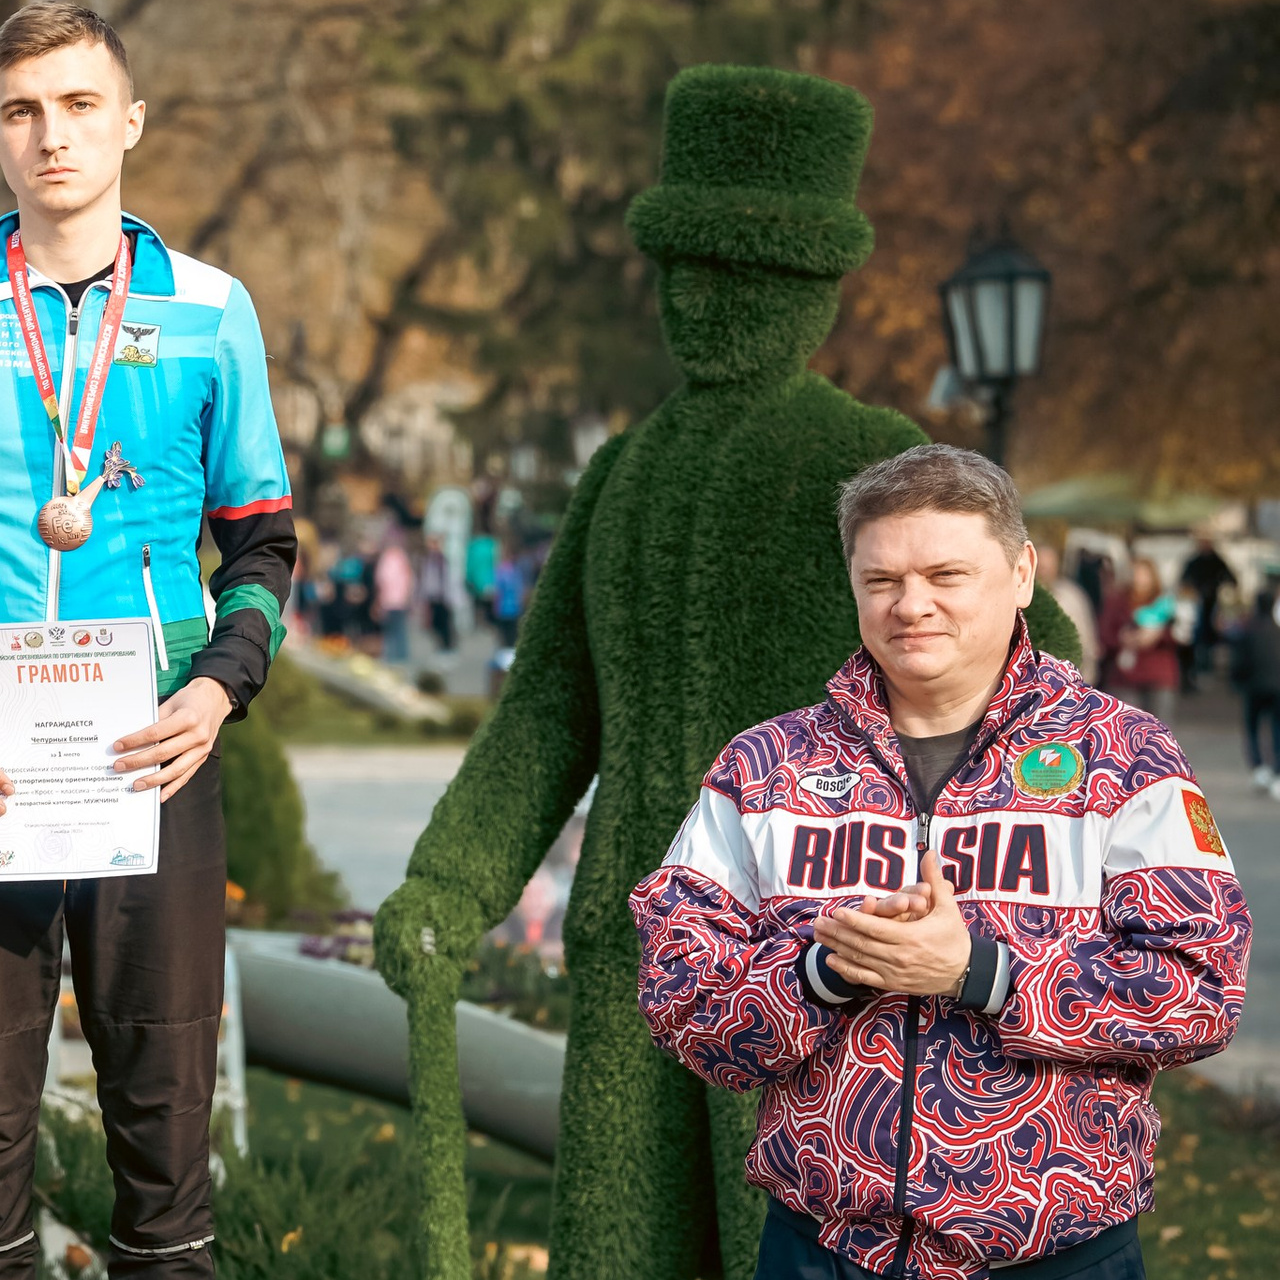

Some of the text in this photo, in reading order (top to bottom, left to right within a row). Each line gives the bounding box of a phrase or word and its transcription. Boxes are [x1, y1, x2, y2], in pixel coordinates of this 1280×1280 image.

[14, 270, 36, 332] ОРИЕНТИРОВАНИЮ
[28, 331, 48, 380] СПОРТИВНОМУ
[41, 380, 50, 391] ПО
[80, 323, 114, 434] ВСЕРОССИЙСКИЕ СОРЕВНОВАНИЯ
[51, 516, 73, 534] Fe
[16, 653, 52, 661] СОРЕВНОВАНИЯ
[93, 650, 137, 658] ОРИЕНТИРОВАНИЮ
[16, 662, 104, 684] ГРАМОТА
[34, 720, 94, 729] НАГРАЖДАЕТСЯ
[30, 734, 99, 744] Чепурных Евгений
[65, 776, 123, 784] ориентированию
[787, 821, 1050, 896] RUSSIA
